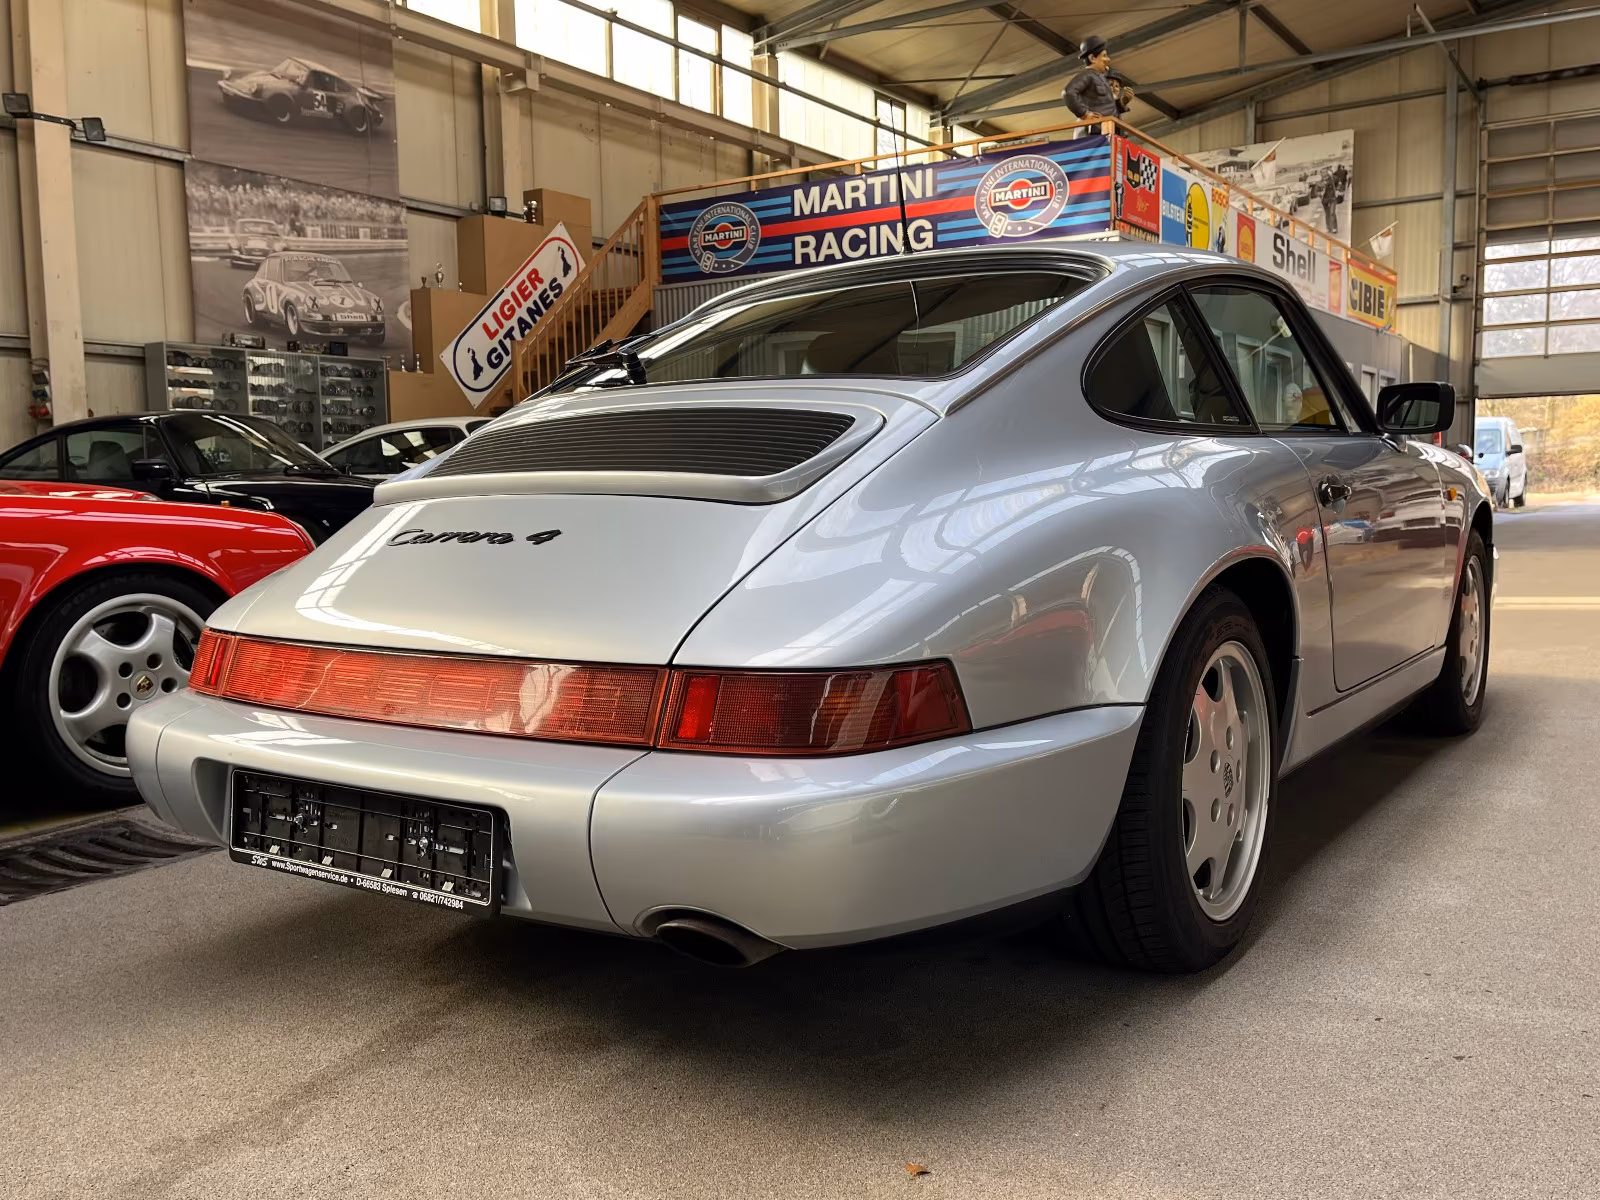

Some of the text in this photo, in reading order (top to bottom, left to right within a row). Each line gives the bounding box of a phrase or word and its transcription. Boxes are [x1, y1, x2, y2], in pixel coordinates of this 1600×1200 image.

[793, 168, 934, 217] MARTINI
[980, 159, 1064, 219] MARTINI INTERNATIONAL CLUB
[995, 185, 1045, 201] MARTINI
[703, 205, 752, 225] INTERNATIONAL
[747, 225, 757, 250] CLUB
[704, 229, 743, 242] MARTINI
[794, 218, 934, 265] RACING
[1272, 232, 1316, 284] Shell
[482, 267, 544, 340] LIGIER
[486, 277, 563, 369] GITANES
[386, 528, 563, 547] Carrera 4
[271, 860, 348, 884] www.Sportwagenservice.de
[356, 877, 381, 891] D-66583
[419, 891, 464, 910] 06821/742984
